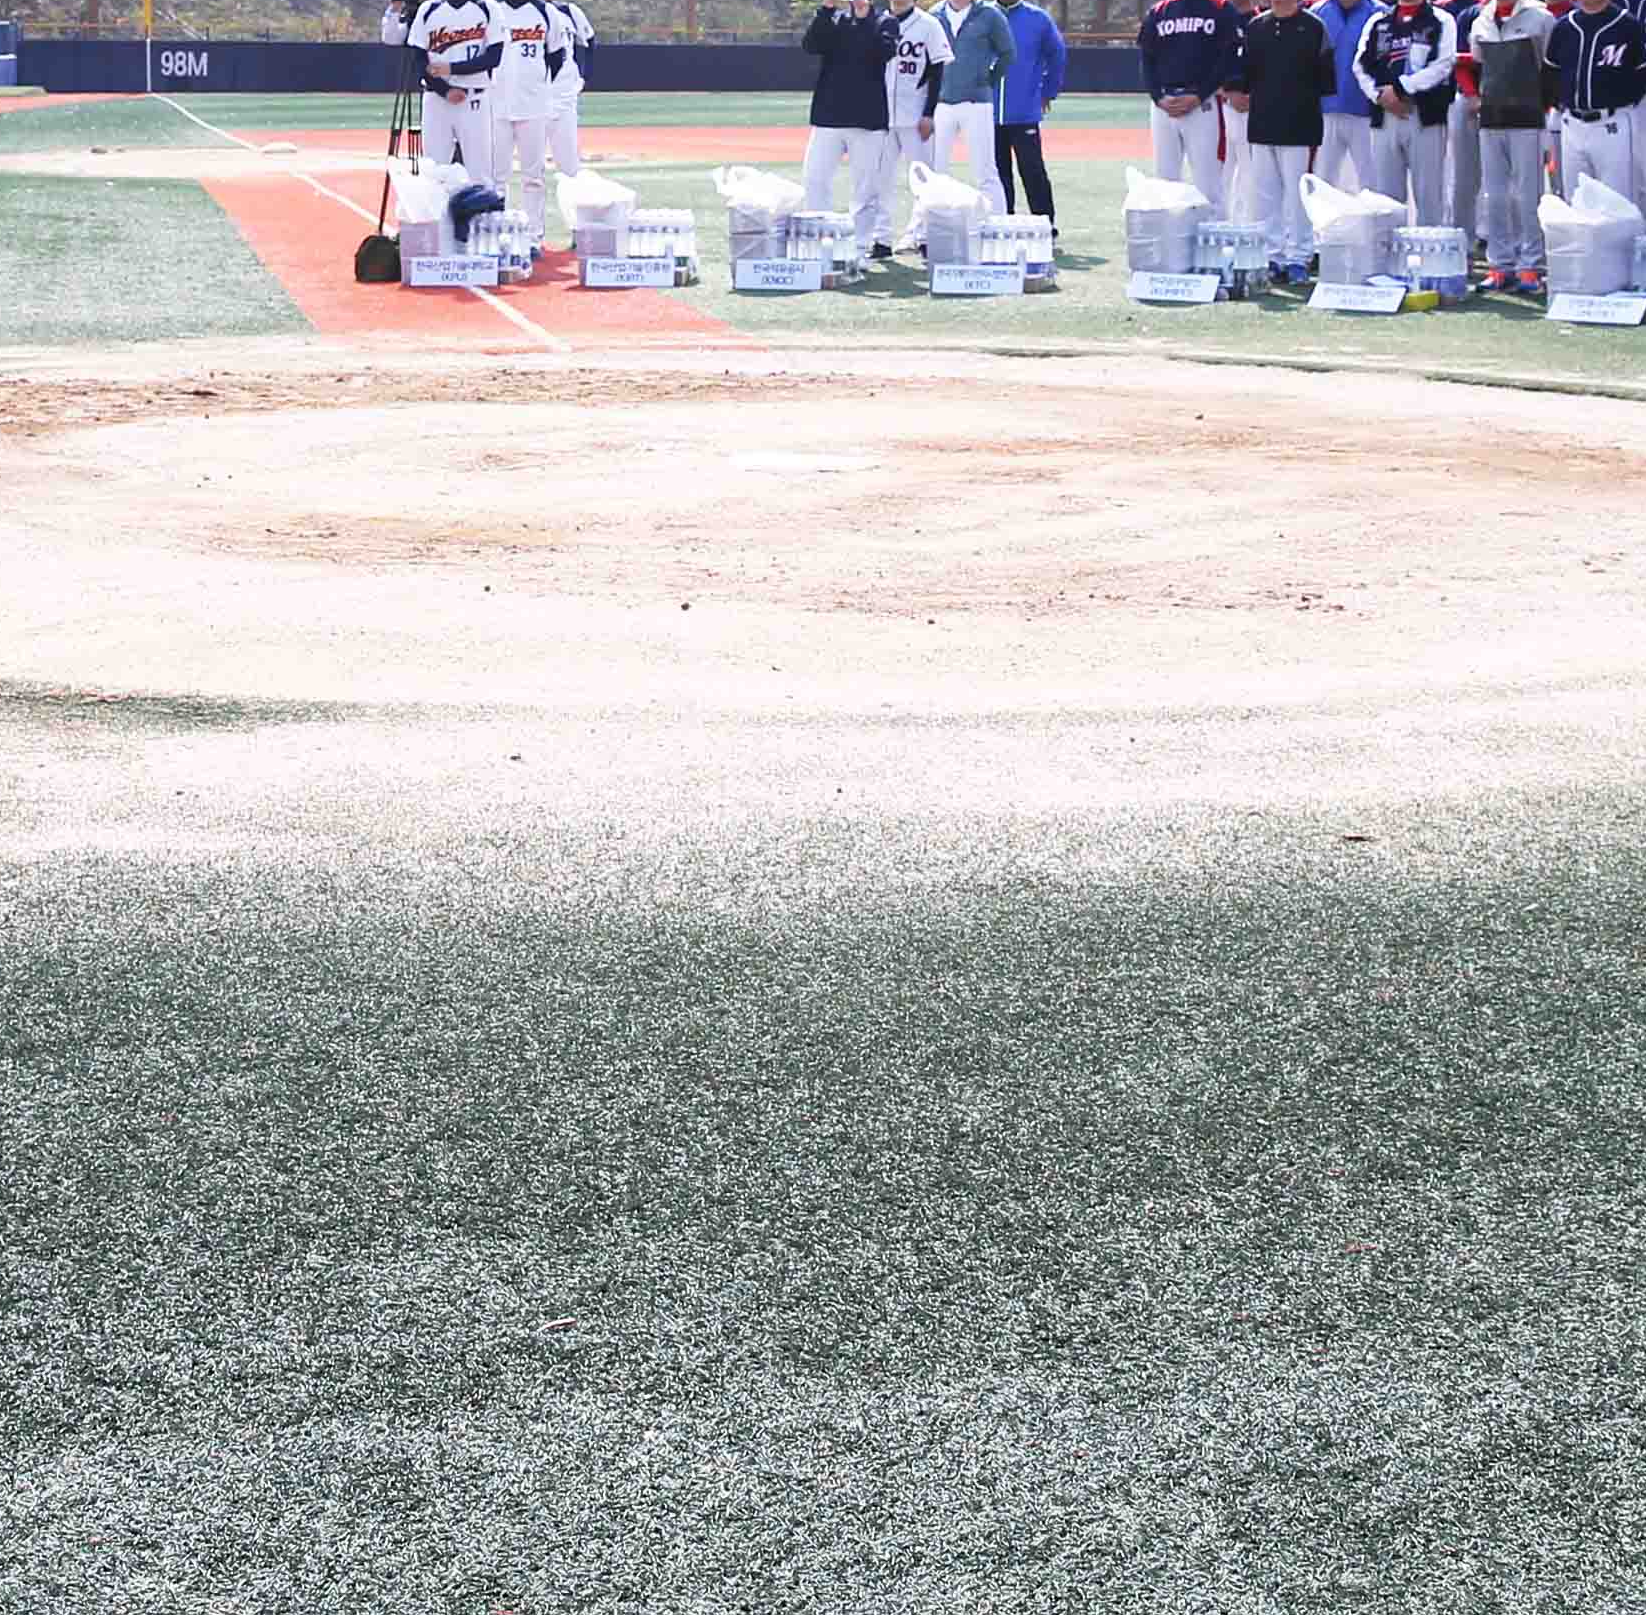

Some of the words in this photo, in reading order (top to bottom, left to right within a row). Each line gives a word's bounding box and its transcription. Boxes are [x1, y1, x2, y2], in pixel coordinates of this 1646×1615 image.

[1156, 16, 1216, 37] KOMIPO
[520, 43, 537, 58] 33
[1596, 42, 1628, 67] M
[160, 51, 209, 77] 98M
